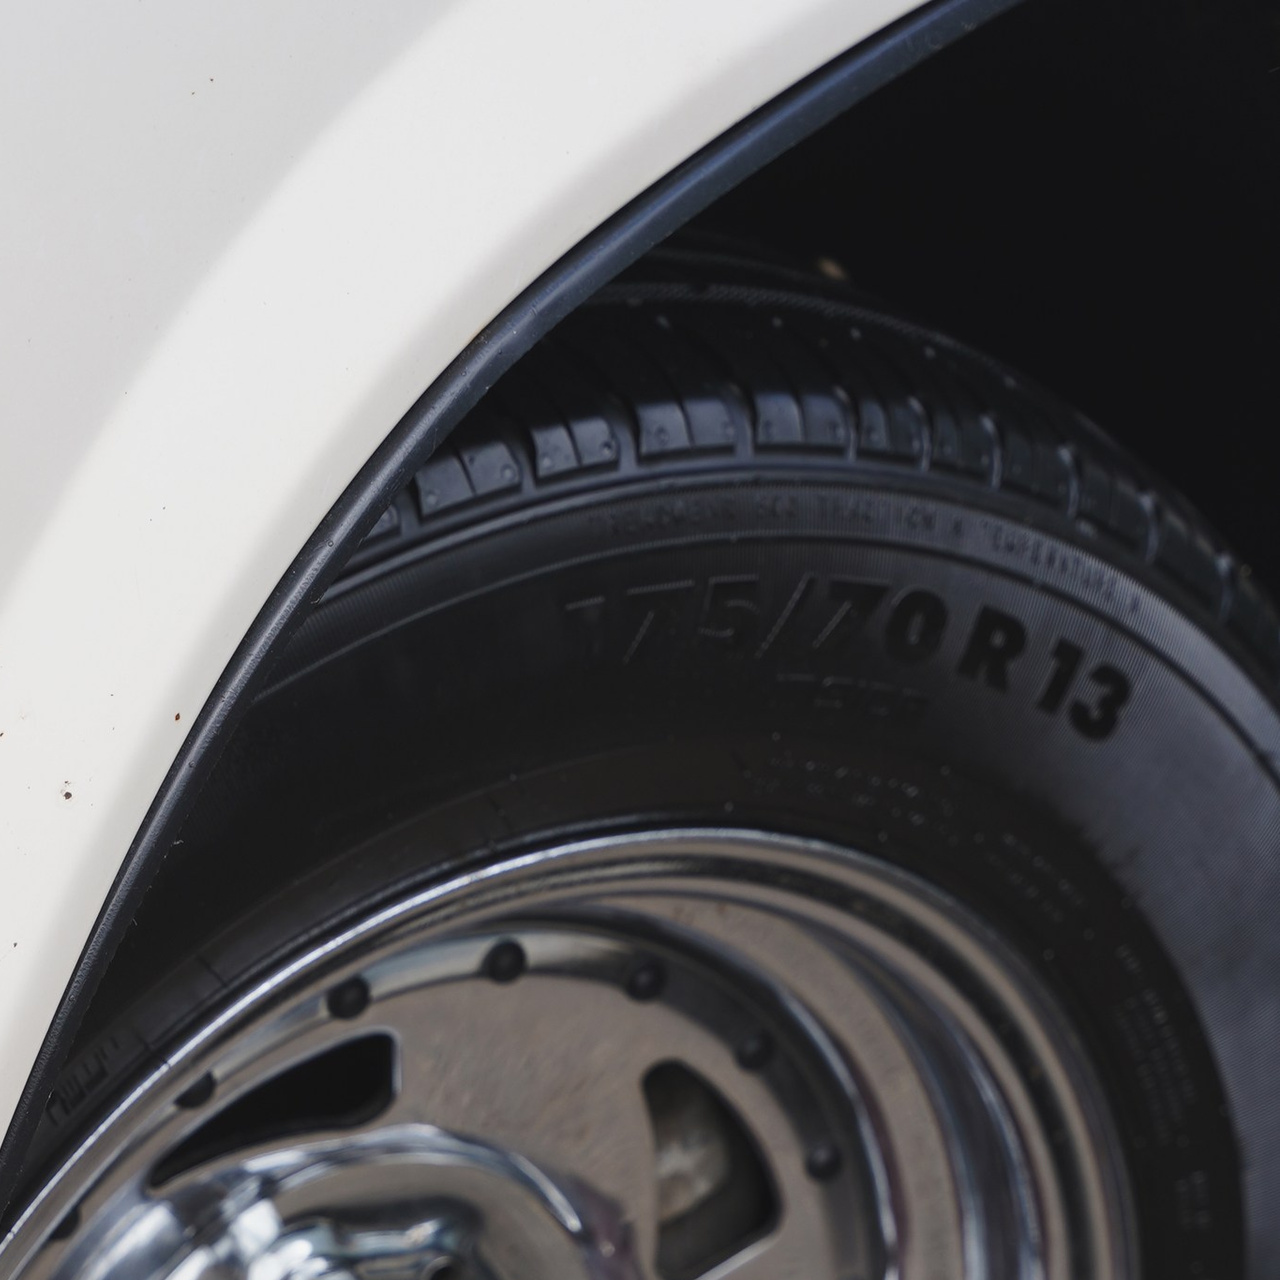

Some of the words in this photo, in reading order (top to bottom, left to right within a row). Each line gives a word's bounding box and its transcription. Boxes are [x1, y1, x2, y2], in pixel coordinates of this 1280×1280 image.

[563, 572, 949, 668] 175/70
[957, 607, 1026, 693] R
[1037, 639, 1134, 743] 13
